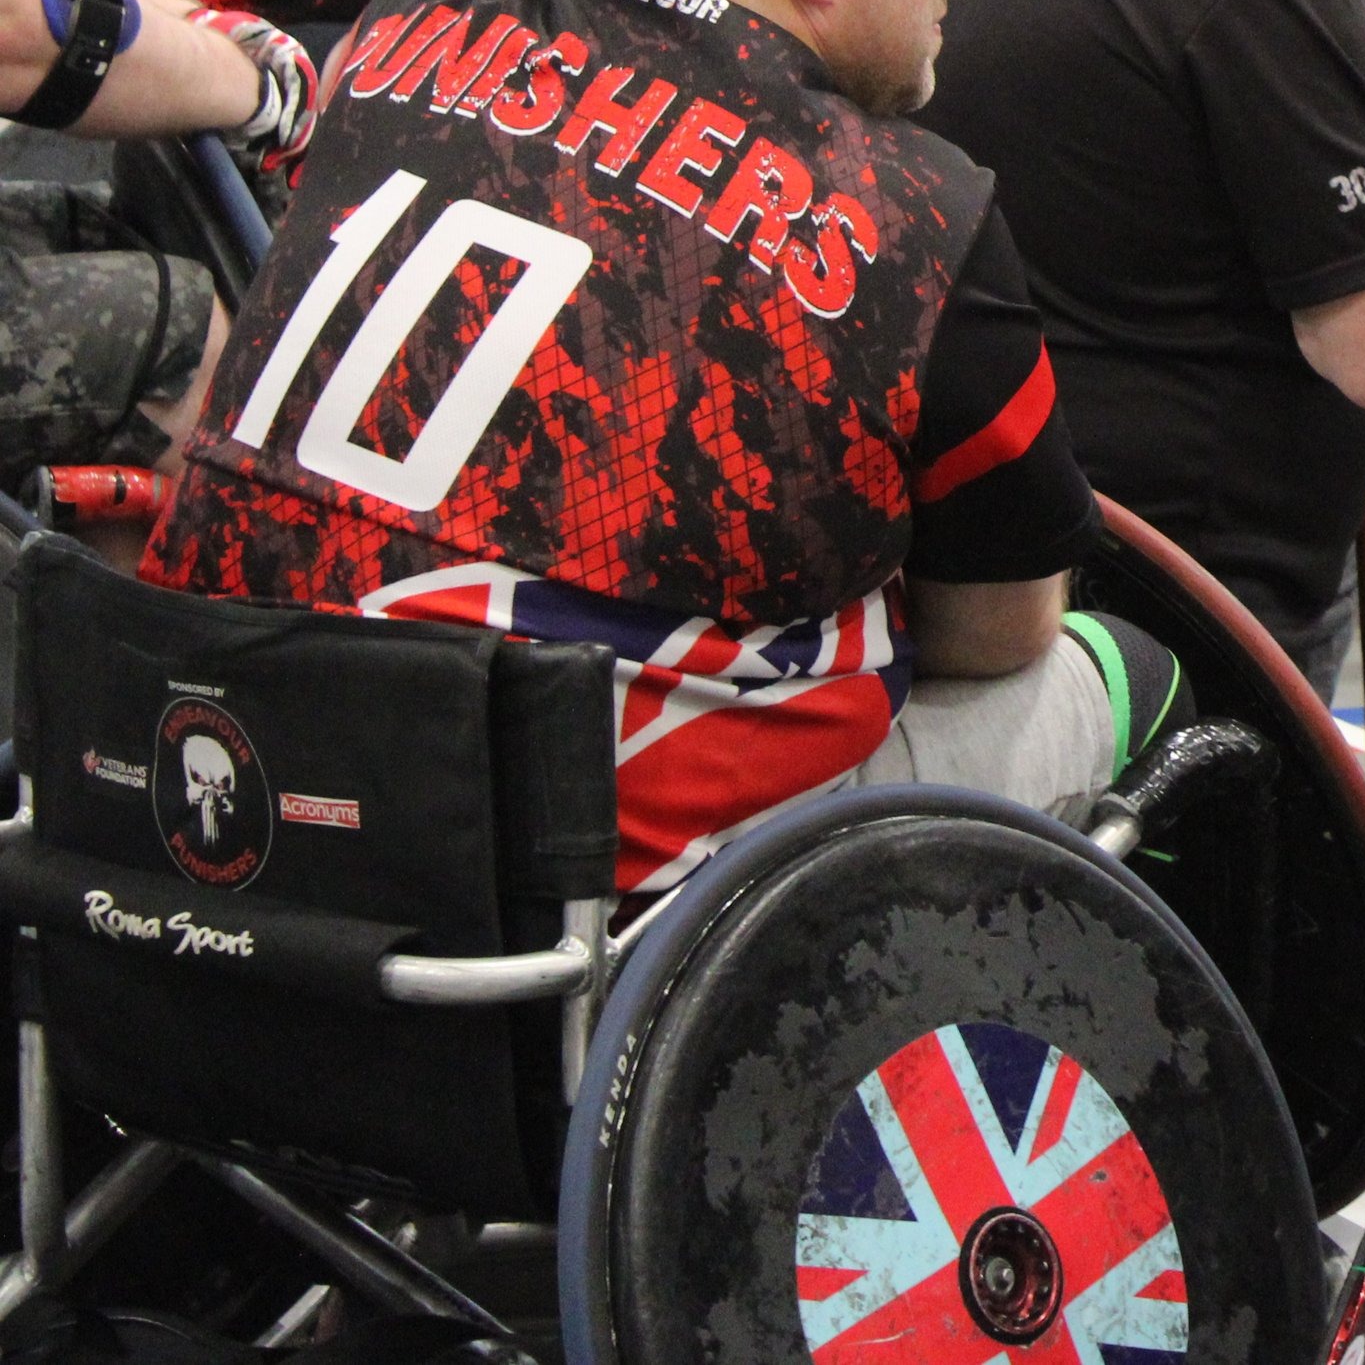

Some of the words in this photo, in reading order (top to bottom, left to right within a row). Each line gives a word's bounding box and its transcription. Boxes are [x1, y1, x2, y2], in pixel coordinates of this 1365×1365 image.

[322, 2, 880, 320] PUNISHERS
[231, 168, 594, 512] 10
[168, 680, 213, 697] SPONSORED
[213, 687, 225, 698] BY
[164, 706, 250, 765] ENDEAVOUR
[96, 766, 147, 789] FOUNDATION
[103, 757, 148, 779] VETERANS
[281, 796, 360, 823] Acronyms
[170, 832, 258, 884] PUNISHERS
[84, 889, 161, 940] Roma
[167, 912, 255, 957] Sport
[598, 1034, 638, 1149] KENDA
